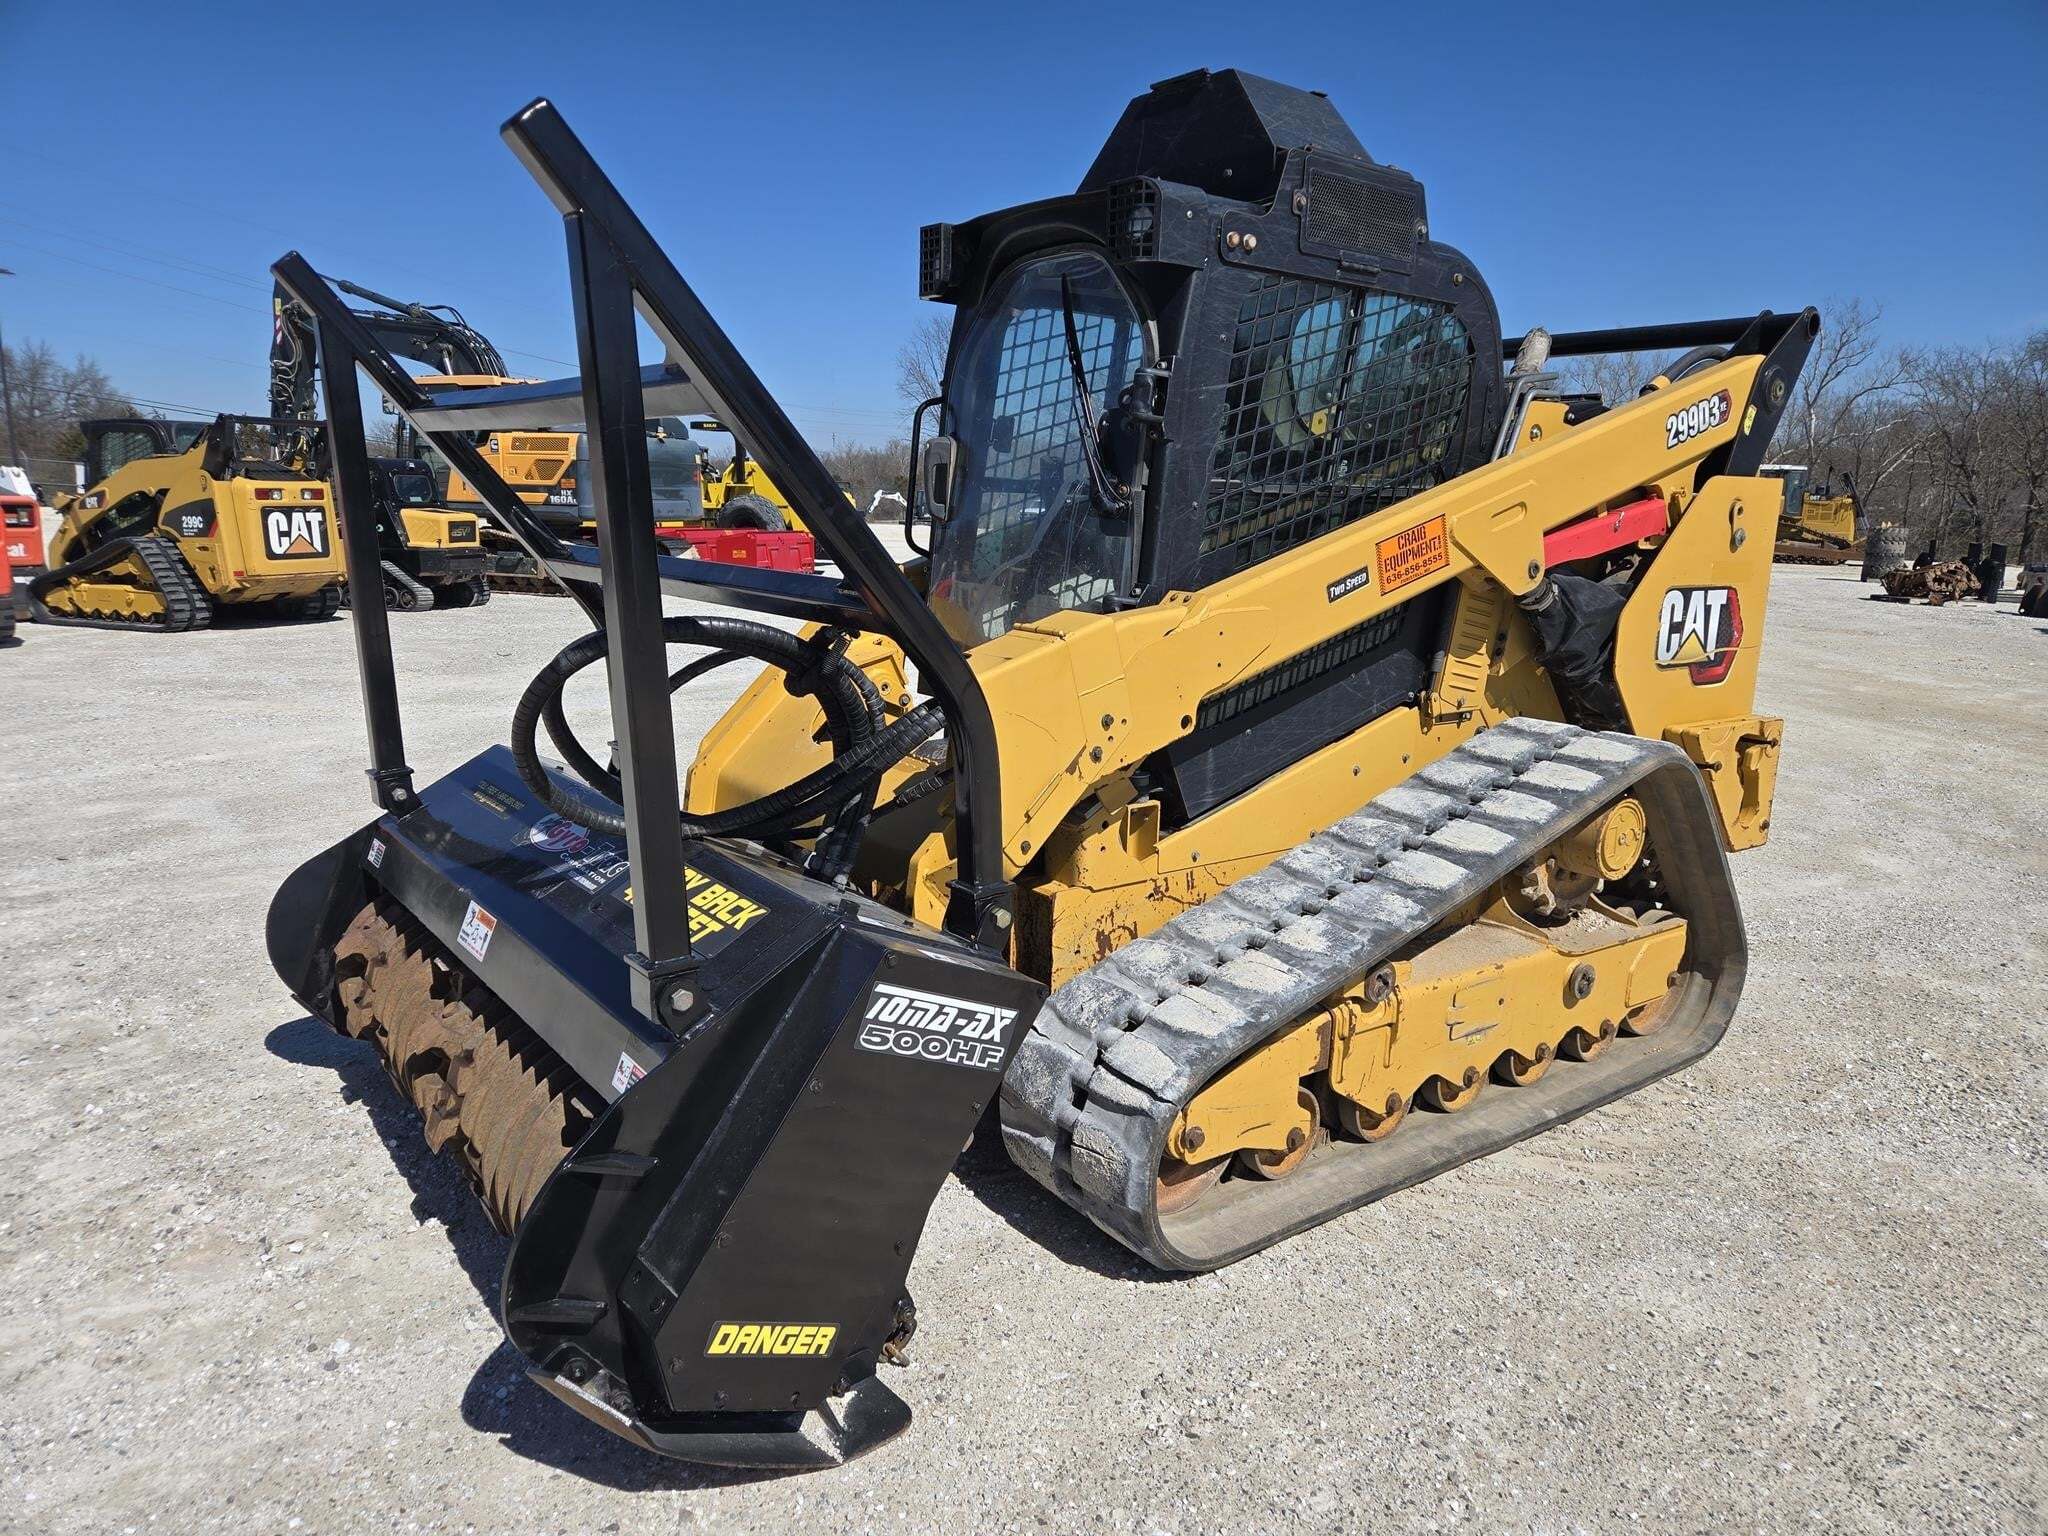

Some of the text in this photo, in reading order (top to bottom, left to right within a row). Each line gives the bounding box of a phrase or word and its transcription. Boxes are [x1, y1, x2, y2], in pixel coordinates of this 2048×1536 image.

[1666, 395, 1720, 448] 299D3
[182, 516, 203, 528] 299C
[267, 511, 324, 555] CAT
[1397, 525, 1427, 550] CRAIG
[1386, 552, 1443, 584] 636-856-8555
[1657, 589, 1728, 665] CAT
[690, 883, 767, 930] BACK
[860, 1023, 1005, 1068] 500HF
[707, 1324, 837, 1355] DANGER
